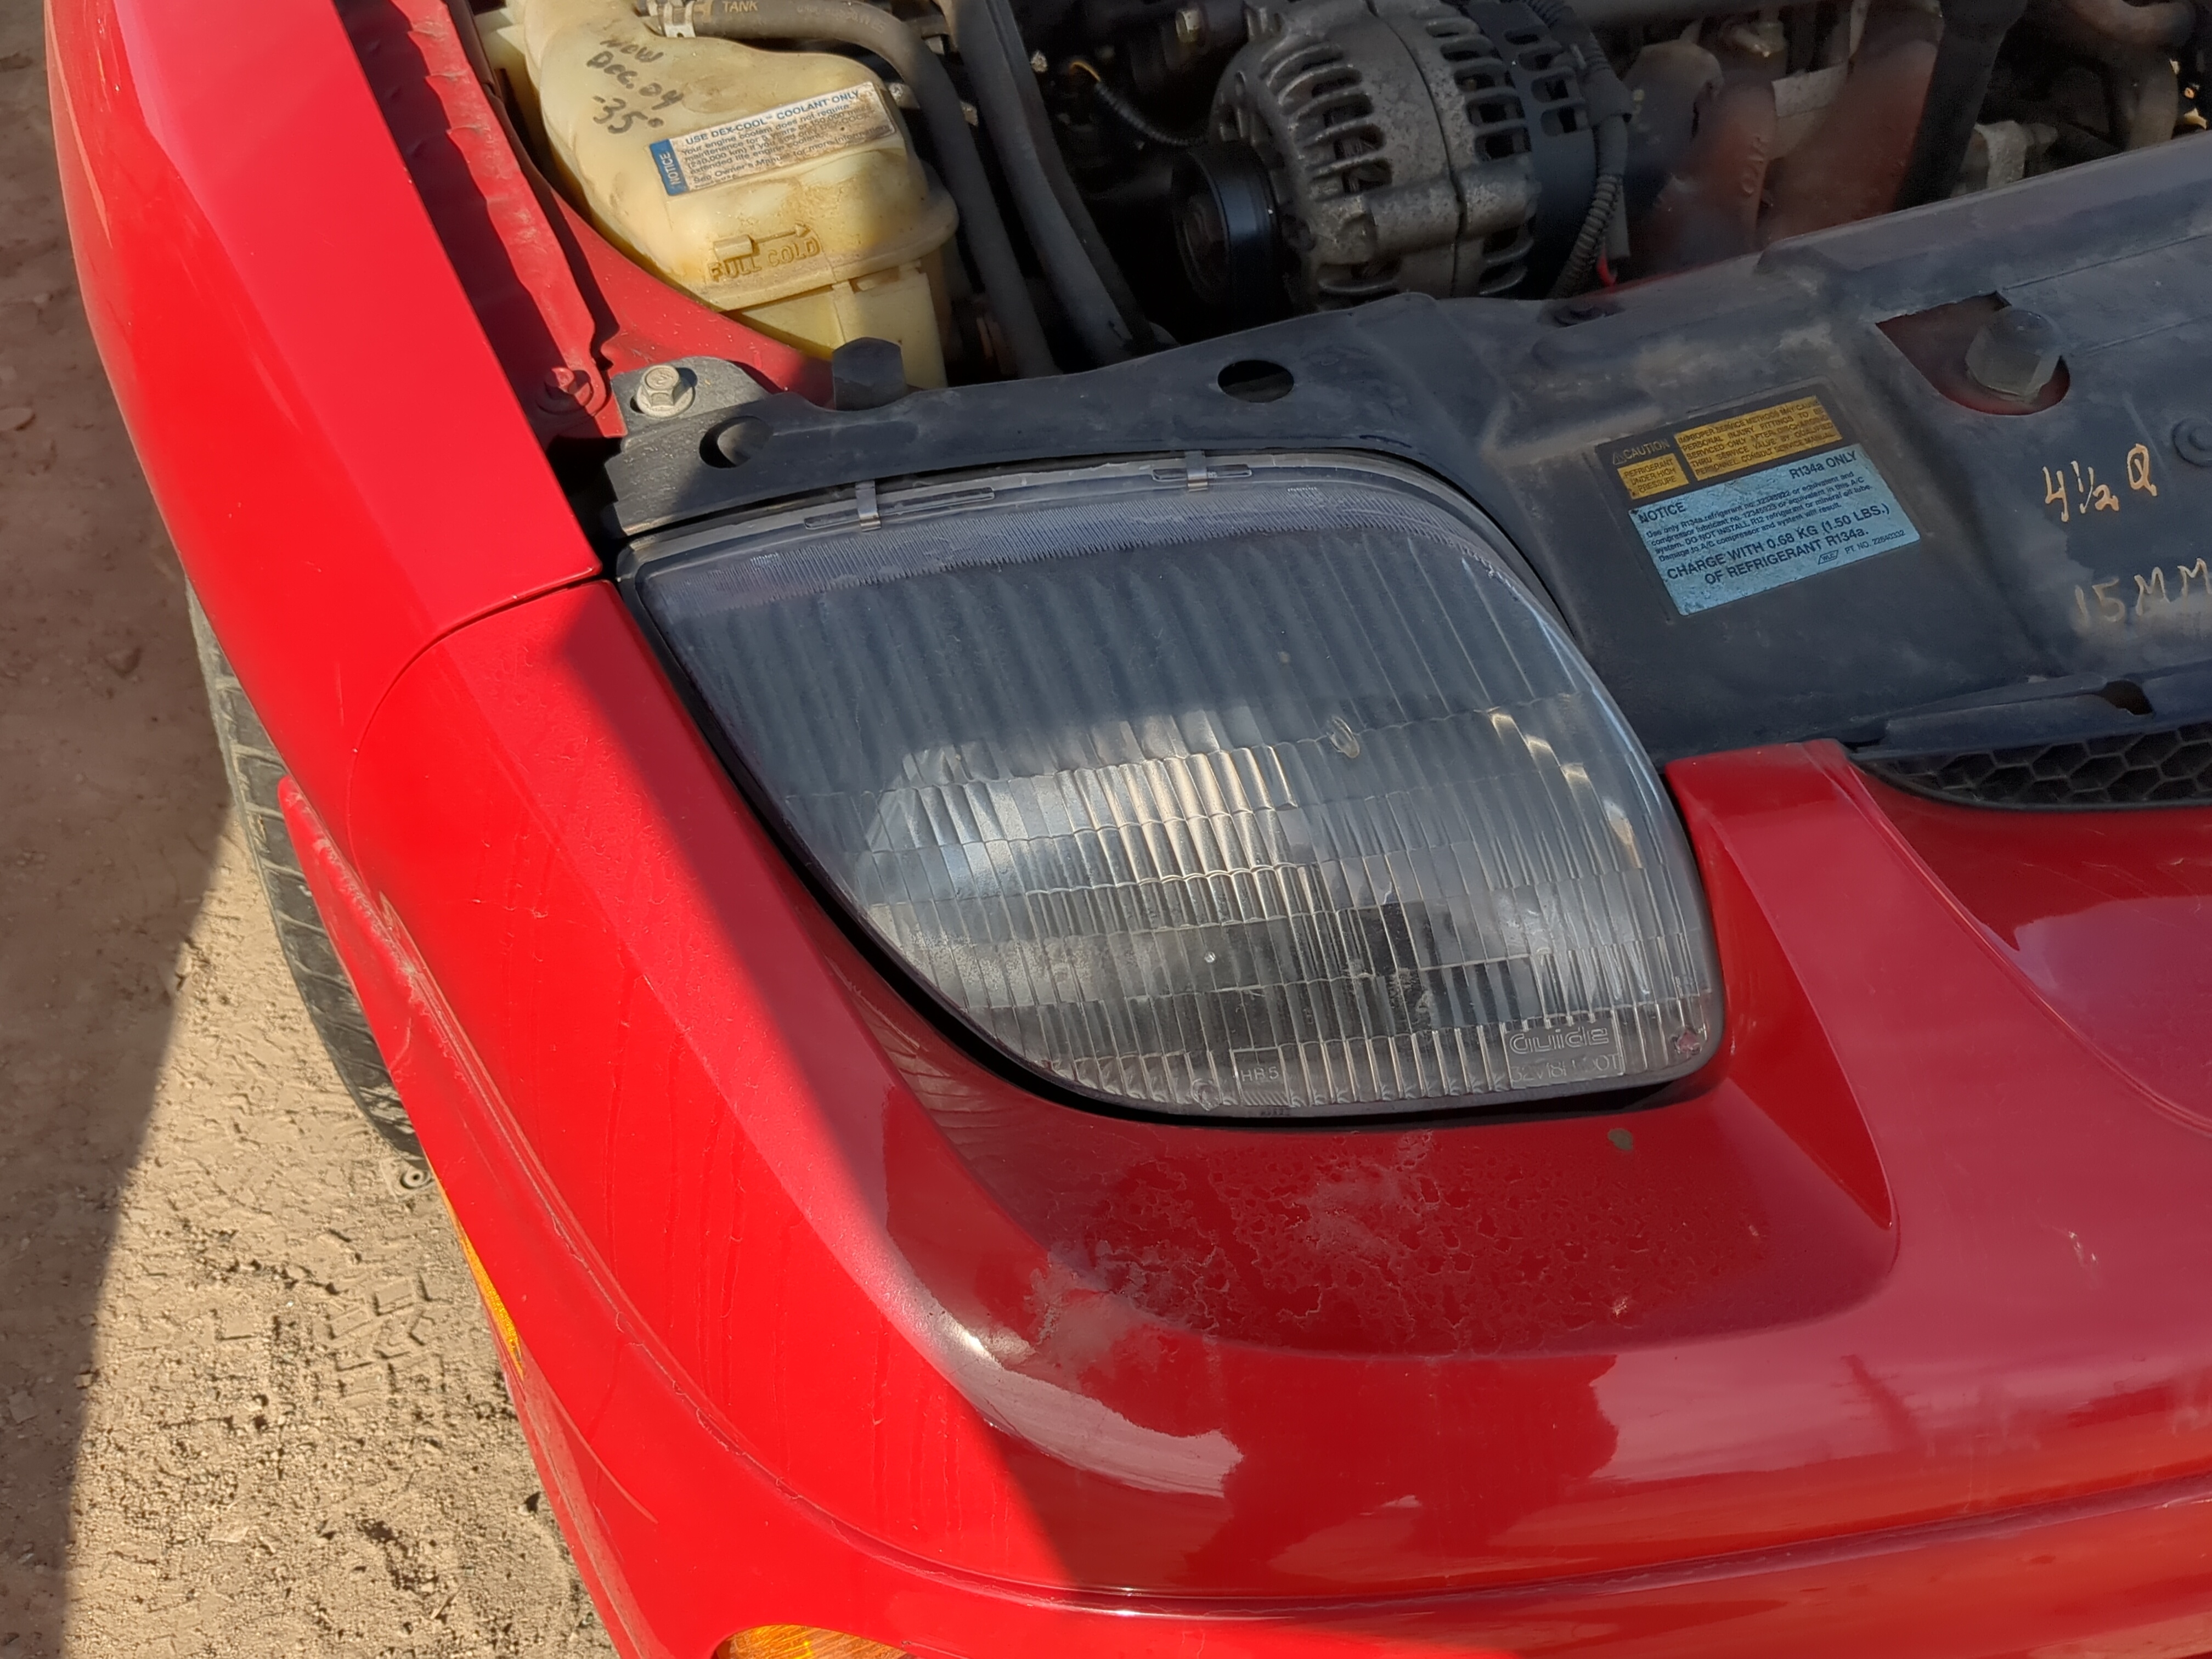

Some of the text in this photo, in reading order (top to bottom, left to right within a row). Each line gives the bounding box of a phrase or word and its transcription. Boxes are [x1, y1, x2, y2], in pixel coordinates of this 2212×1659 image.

[722, 1, 758, 13] TANK
[639, 83, 684, 110] 04
[681, 104, 849, 156] Your engine coolant does not require
[686, 134, 708, 145] USE
[776, 100, 827, 120] COOLANT
[831, 91, 860, 104] ONLY
[684, 140, 744, 162] maintenance
[746, 136, 759, 144] for
[659, 150, 681, 185] NOTICE
[689, 157, 733, 175] extended
[768, 236, 820, 267] COLD
[1622, 439, 1669, 459] CAUTION
[1682, 435, 1723, 451] PERSONAL
[1759, 416, 1794, 430] FITTINGS
[1686, 443, 1724, 459] SERVICED
[1690, 456, 1713, 467] THRU
[1716, 446, 1749, 460] SERVICE
[1752, 438, 1776, 449] VALVE
[1788, 451, 1859, 478] R134a ONLY
[1630, 467, 1676, 484] UNDER HIGH
[1637, 475, 1677, 492] PRESSURE
[2042, 466, 2069, 522] 4
[2127, 443, 2158, 496] Q
[1638, 502, 1685, 523] NOTICE
[1646, 529, 1661, 539] Use
[1663, 523, 1679, 534] only
[1802, 476, 1839, 492] equivalent
[1839, 471, 1855, 481] and
[1650, 528, 1694, 546] compressor
[1787, 489, 1825, 505] equivalent
[1835, 481, 1849, 490] this
[1850, 477, 1865, 486] A/C
[1685, 536, 1699, 545] DO
[1699, 531, 1716, 541] NOT
[1717, 521, 1750, 535] INSTALL
[1750, 516, 1764, 526] R12
[1765, 504, 1804, 521] refrigerant
[1814, 493, 1842, 506] mineral
[1658, 548, 1690, 562] Damage
[1700, 540, 1715, 550] A/C
[1716, 527, 1760, 545] compressor
[1761, 522, 1775, 531] and
[1776, 513, 1803, 526] system
[1666, 503, 1890, 580] CHARGE WITH 0.68 KG (1.50 LBS.)
[1704, 526, 1869, 584] OF REFRIGERANT R134a.
[2075, 577, 2126, 623] 15
